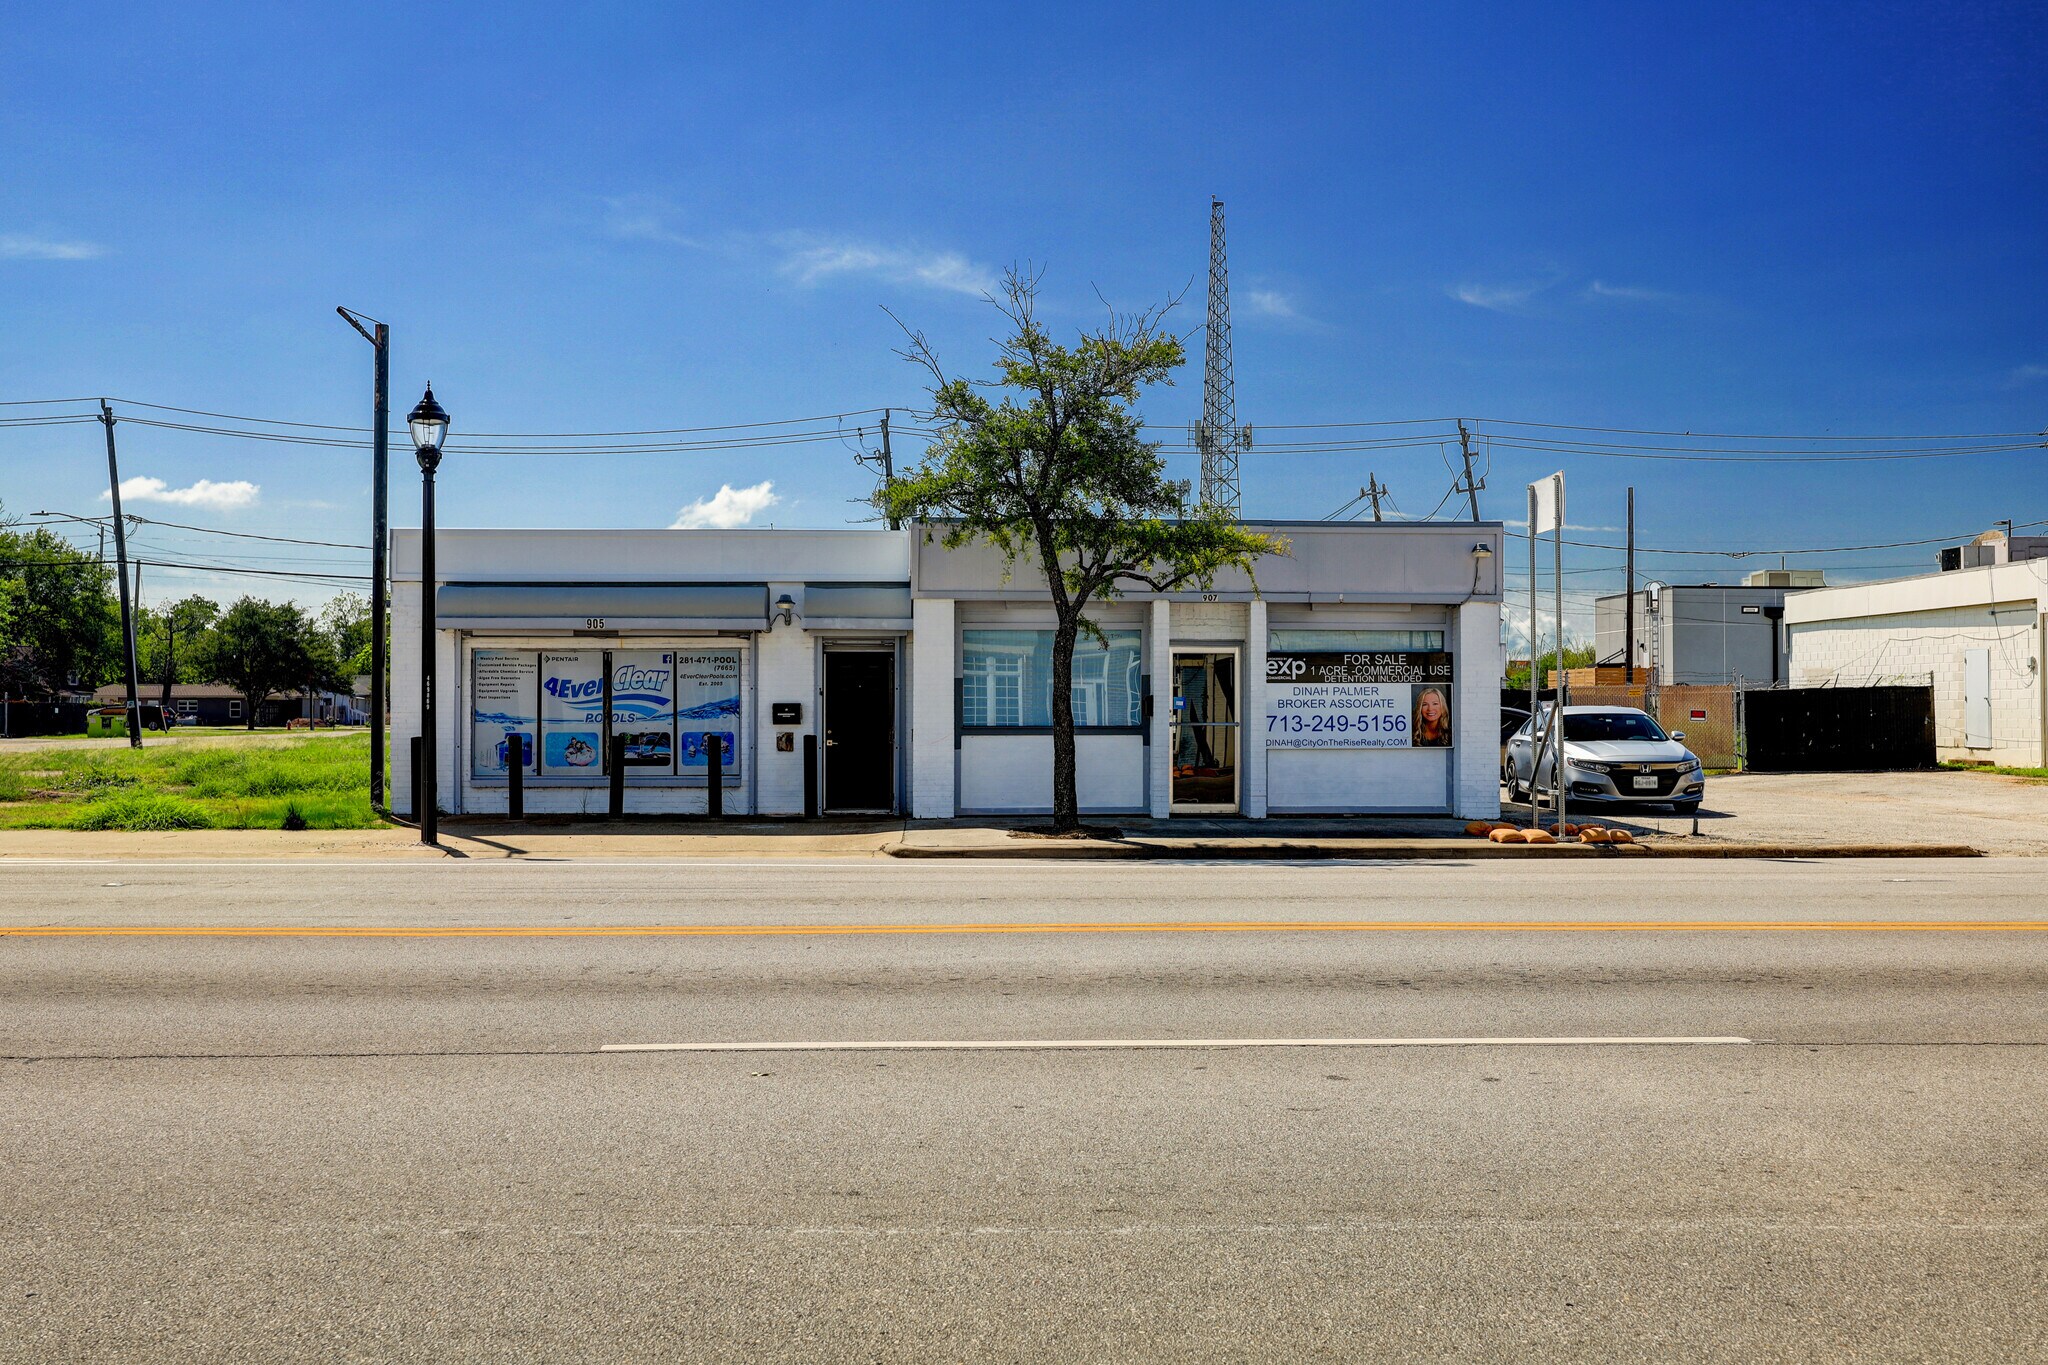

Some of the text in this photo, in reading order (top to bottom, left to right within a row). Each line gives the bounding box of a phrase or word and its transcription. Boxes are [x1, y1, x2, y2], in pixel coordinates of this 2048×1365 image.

[1202, 594, 1218, 602] 907
[586, 618, 605, 629] 905
[679, 656, 737, 664] 281-471-POOL
[1344, 654, 1407, 665] FOR SALE
[1310, 665, 1451, 676] 1 ACRE -COMMERCIAL USE
[612, 664, 670, 692] Clear
[1324, 675, 1422, 683] DETENTION INLCUDED
[1292, 686, 1380, 696] DINAH PALMER
[1277, 699, 1395, 709] BROKER ASSOCIATE
[585, 713, 636, 723] POOLS
[1266, 715, 1407, 732] 713-249-5156
[1266, 738, 1408, 748] DINAH@CityOnTheRiseRealty.COM
